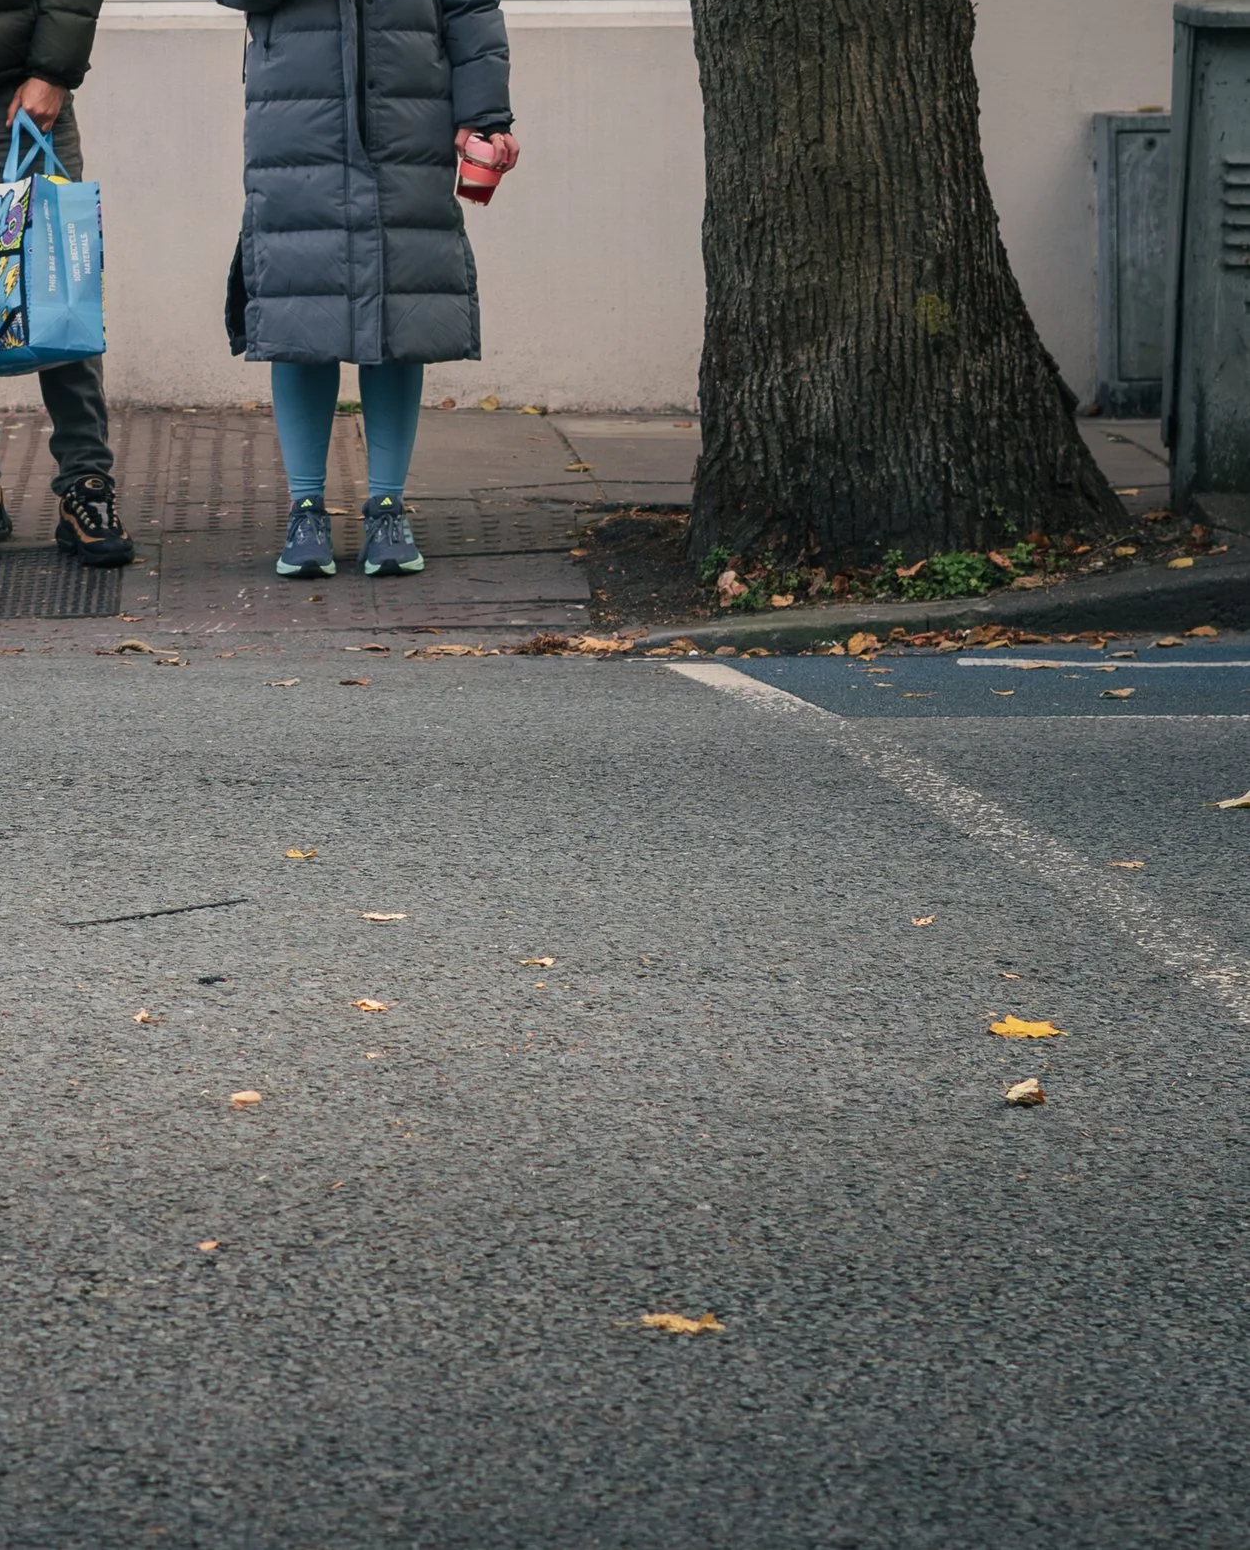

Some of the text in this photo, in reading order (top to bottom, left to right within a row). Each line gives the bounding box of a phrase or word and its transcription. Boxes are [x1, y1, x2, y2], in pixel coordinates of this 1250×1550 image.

[67, 222, 79, 261] RECYCLED
[48, 255, 56, 271] BAG
[48, 274, 56, 292] THIS
